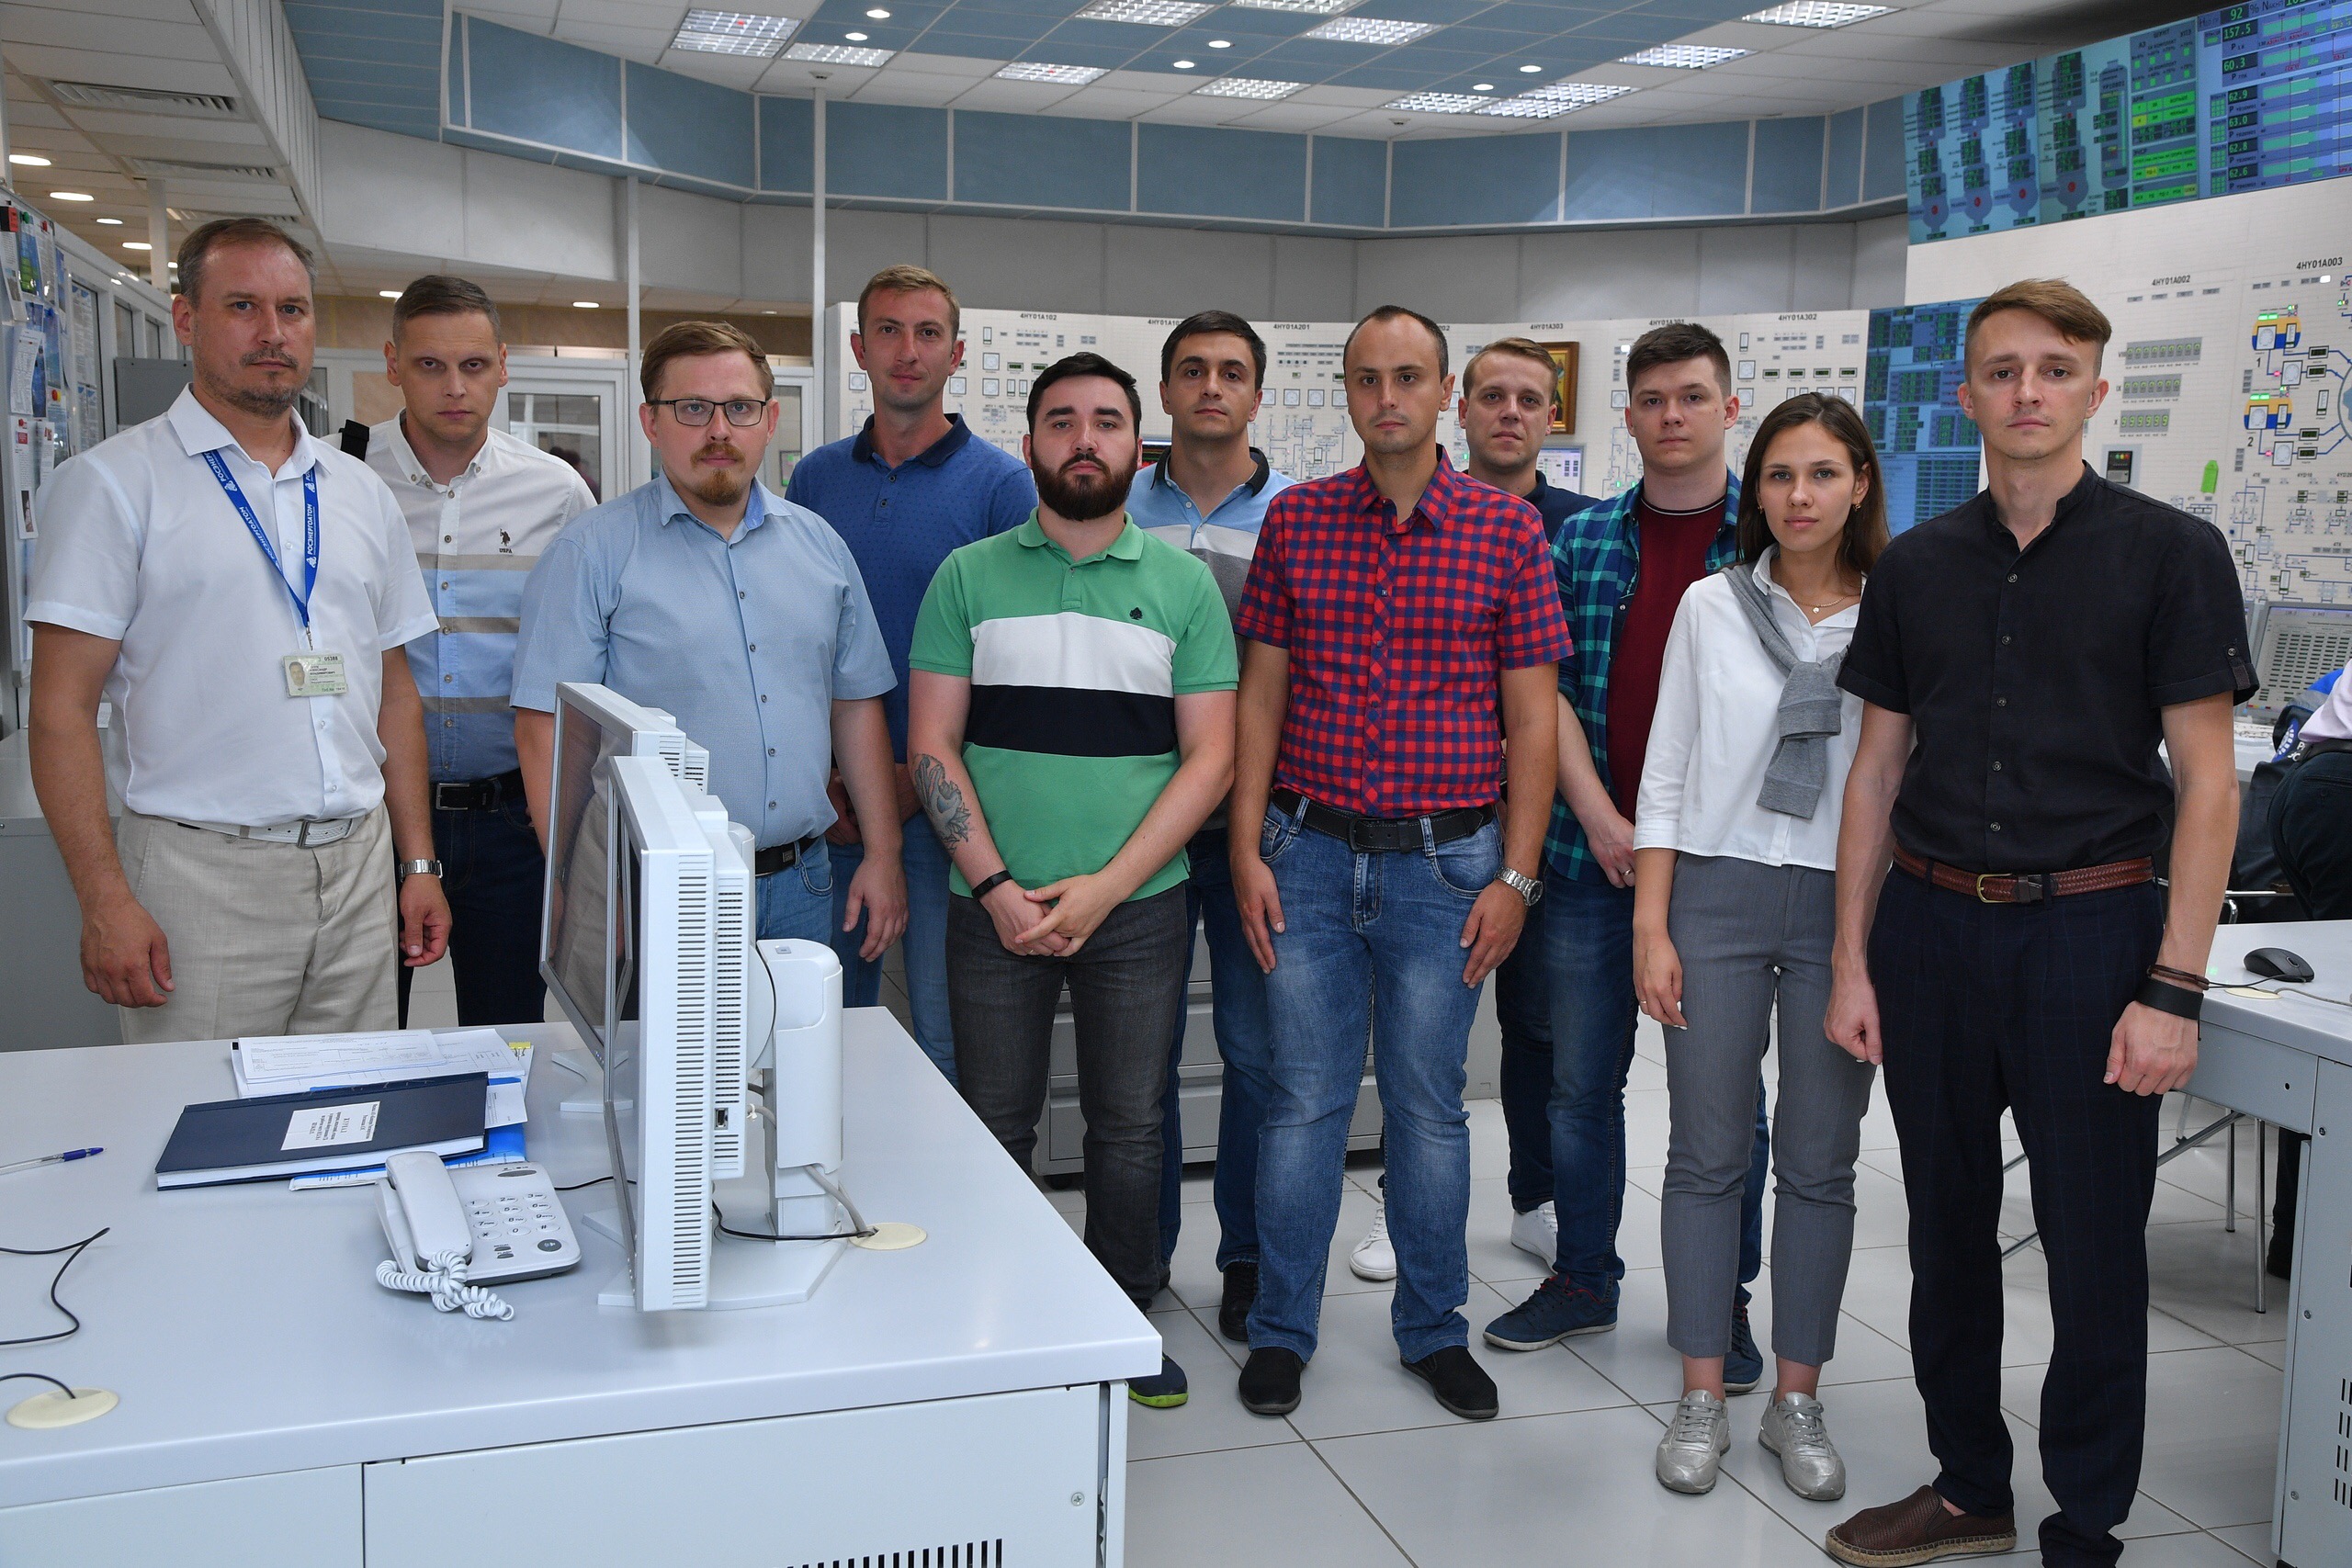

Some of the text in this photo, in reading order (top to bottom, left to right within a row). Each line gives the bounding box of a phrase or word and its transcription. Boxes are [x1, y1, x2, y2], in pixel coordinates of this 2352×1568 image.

[2230, 7, 2243, 21] 92
[2223, 23, 2252, 40] 157.5
[2223, 57, 2246, 71] 60.3
[2228, 89, 2248, 102] 62.9
[2228, 115, 2248, 128] 63.0
[2228, 141, 2248, 154] 62.8
[2228, 166, 2248, 179] 62.6
[2296, 256, 2343, 270] 4HY01A003
[2152, 275, 2191, 286] 4HY01A002
[1019, 313, 1057, 321] 4HY01A102
[1778, 313, 1817, 321] 4HY01A302
[1530, 322, 1564, 331] 4HY01A303
[2256, 357, 2262, 367] 1
[2247, 436, 2254, 447] 2
